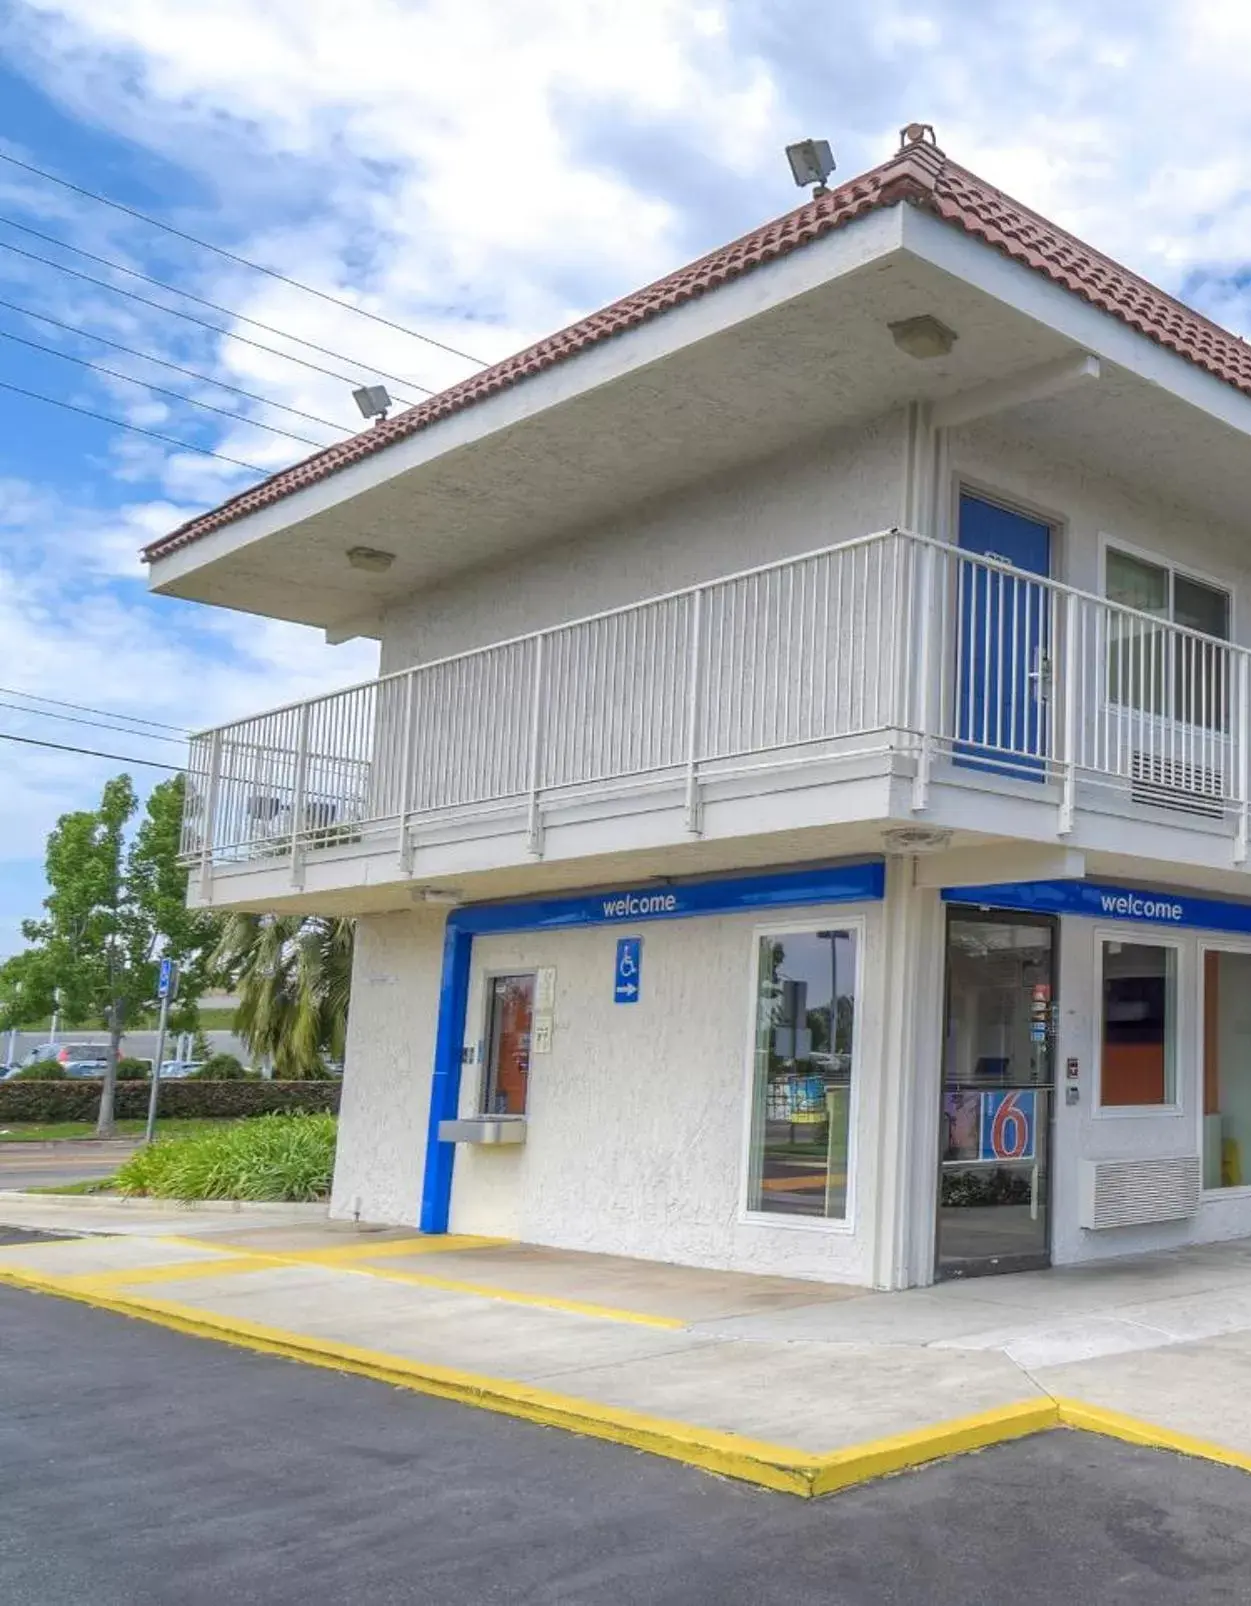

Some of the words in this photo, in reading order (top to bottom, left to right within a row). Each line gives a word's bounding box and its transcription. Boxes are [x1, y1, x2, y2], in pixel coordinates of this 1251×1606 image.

[602, 893, 677, 917] welcome
[1100, 893, 1183, 920] welcome
[991, 1088, 1028, 1160] 6
